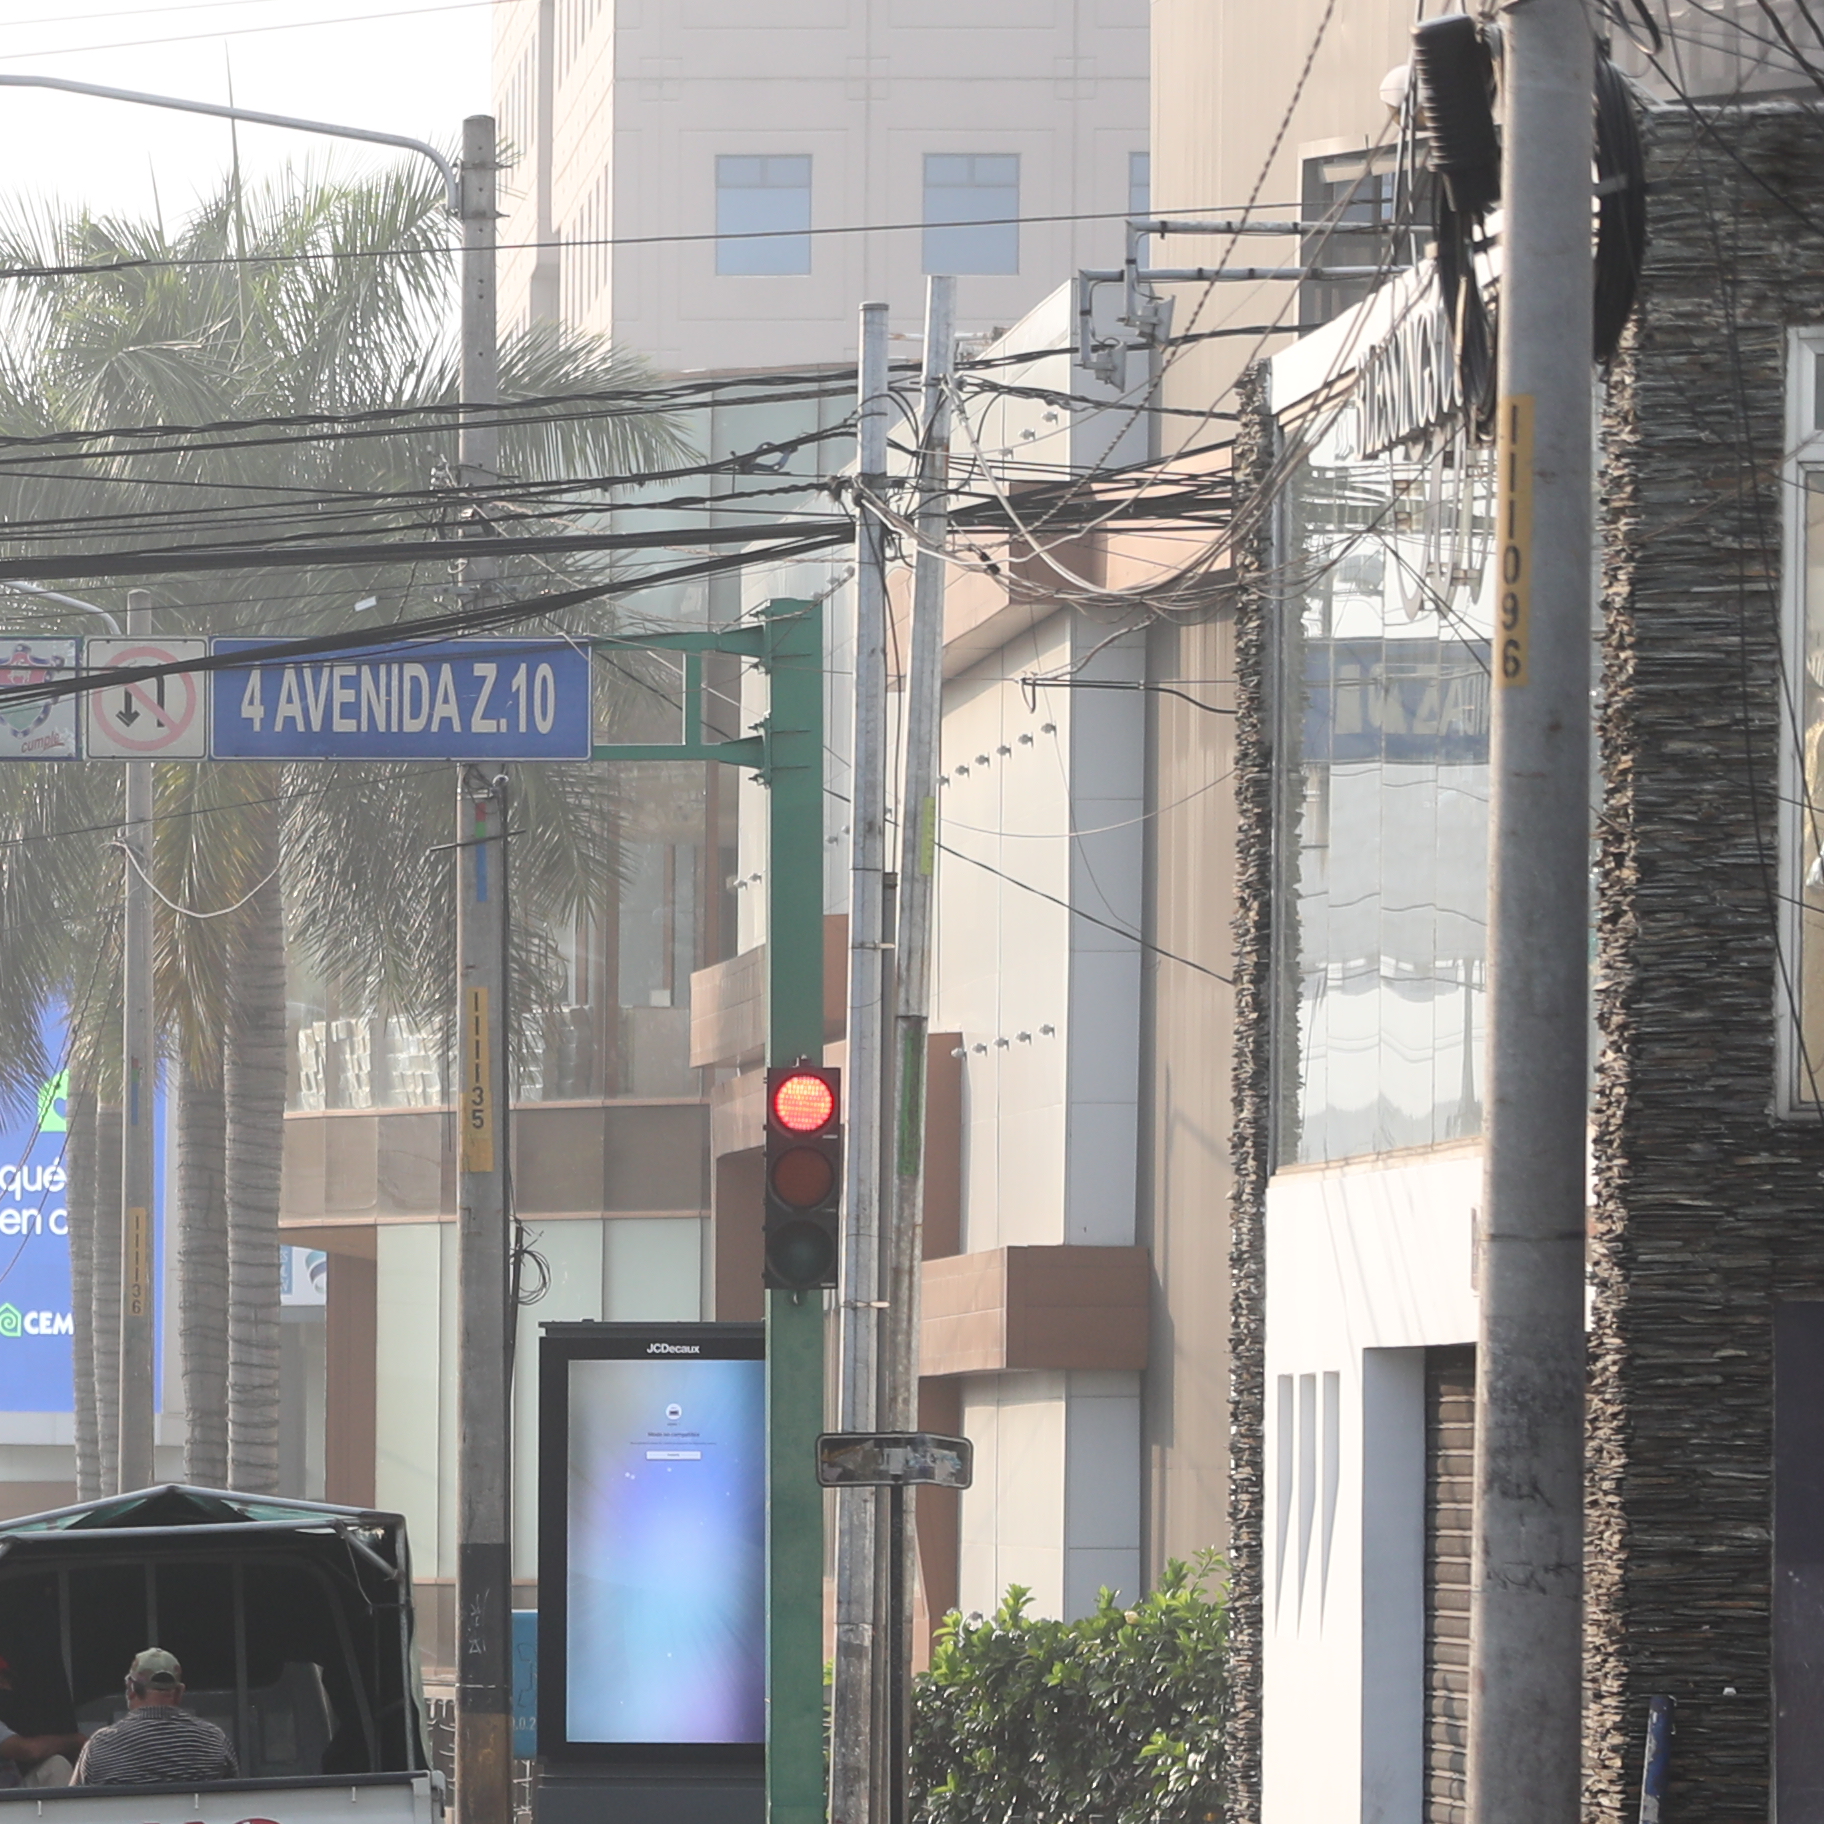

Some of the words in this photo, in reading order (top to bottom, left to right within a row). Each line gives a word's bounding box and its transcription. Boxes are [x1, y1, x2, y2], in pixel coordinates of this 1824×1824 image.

[240, 663, 264, 733] 4
[273, 663, 462, 734] AVENIDA
[469, 663, 554, 735] Z.10
[471, 991, 485, 1130] 111135
[646, 1343, 701, 1354] JCDecaux
